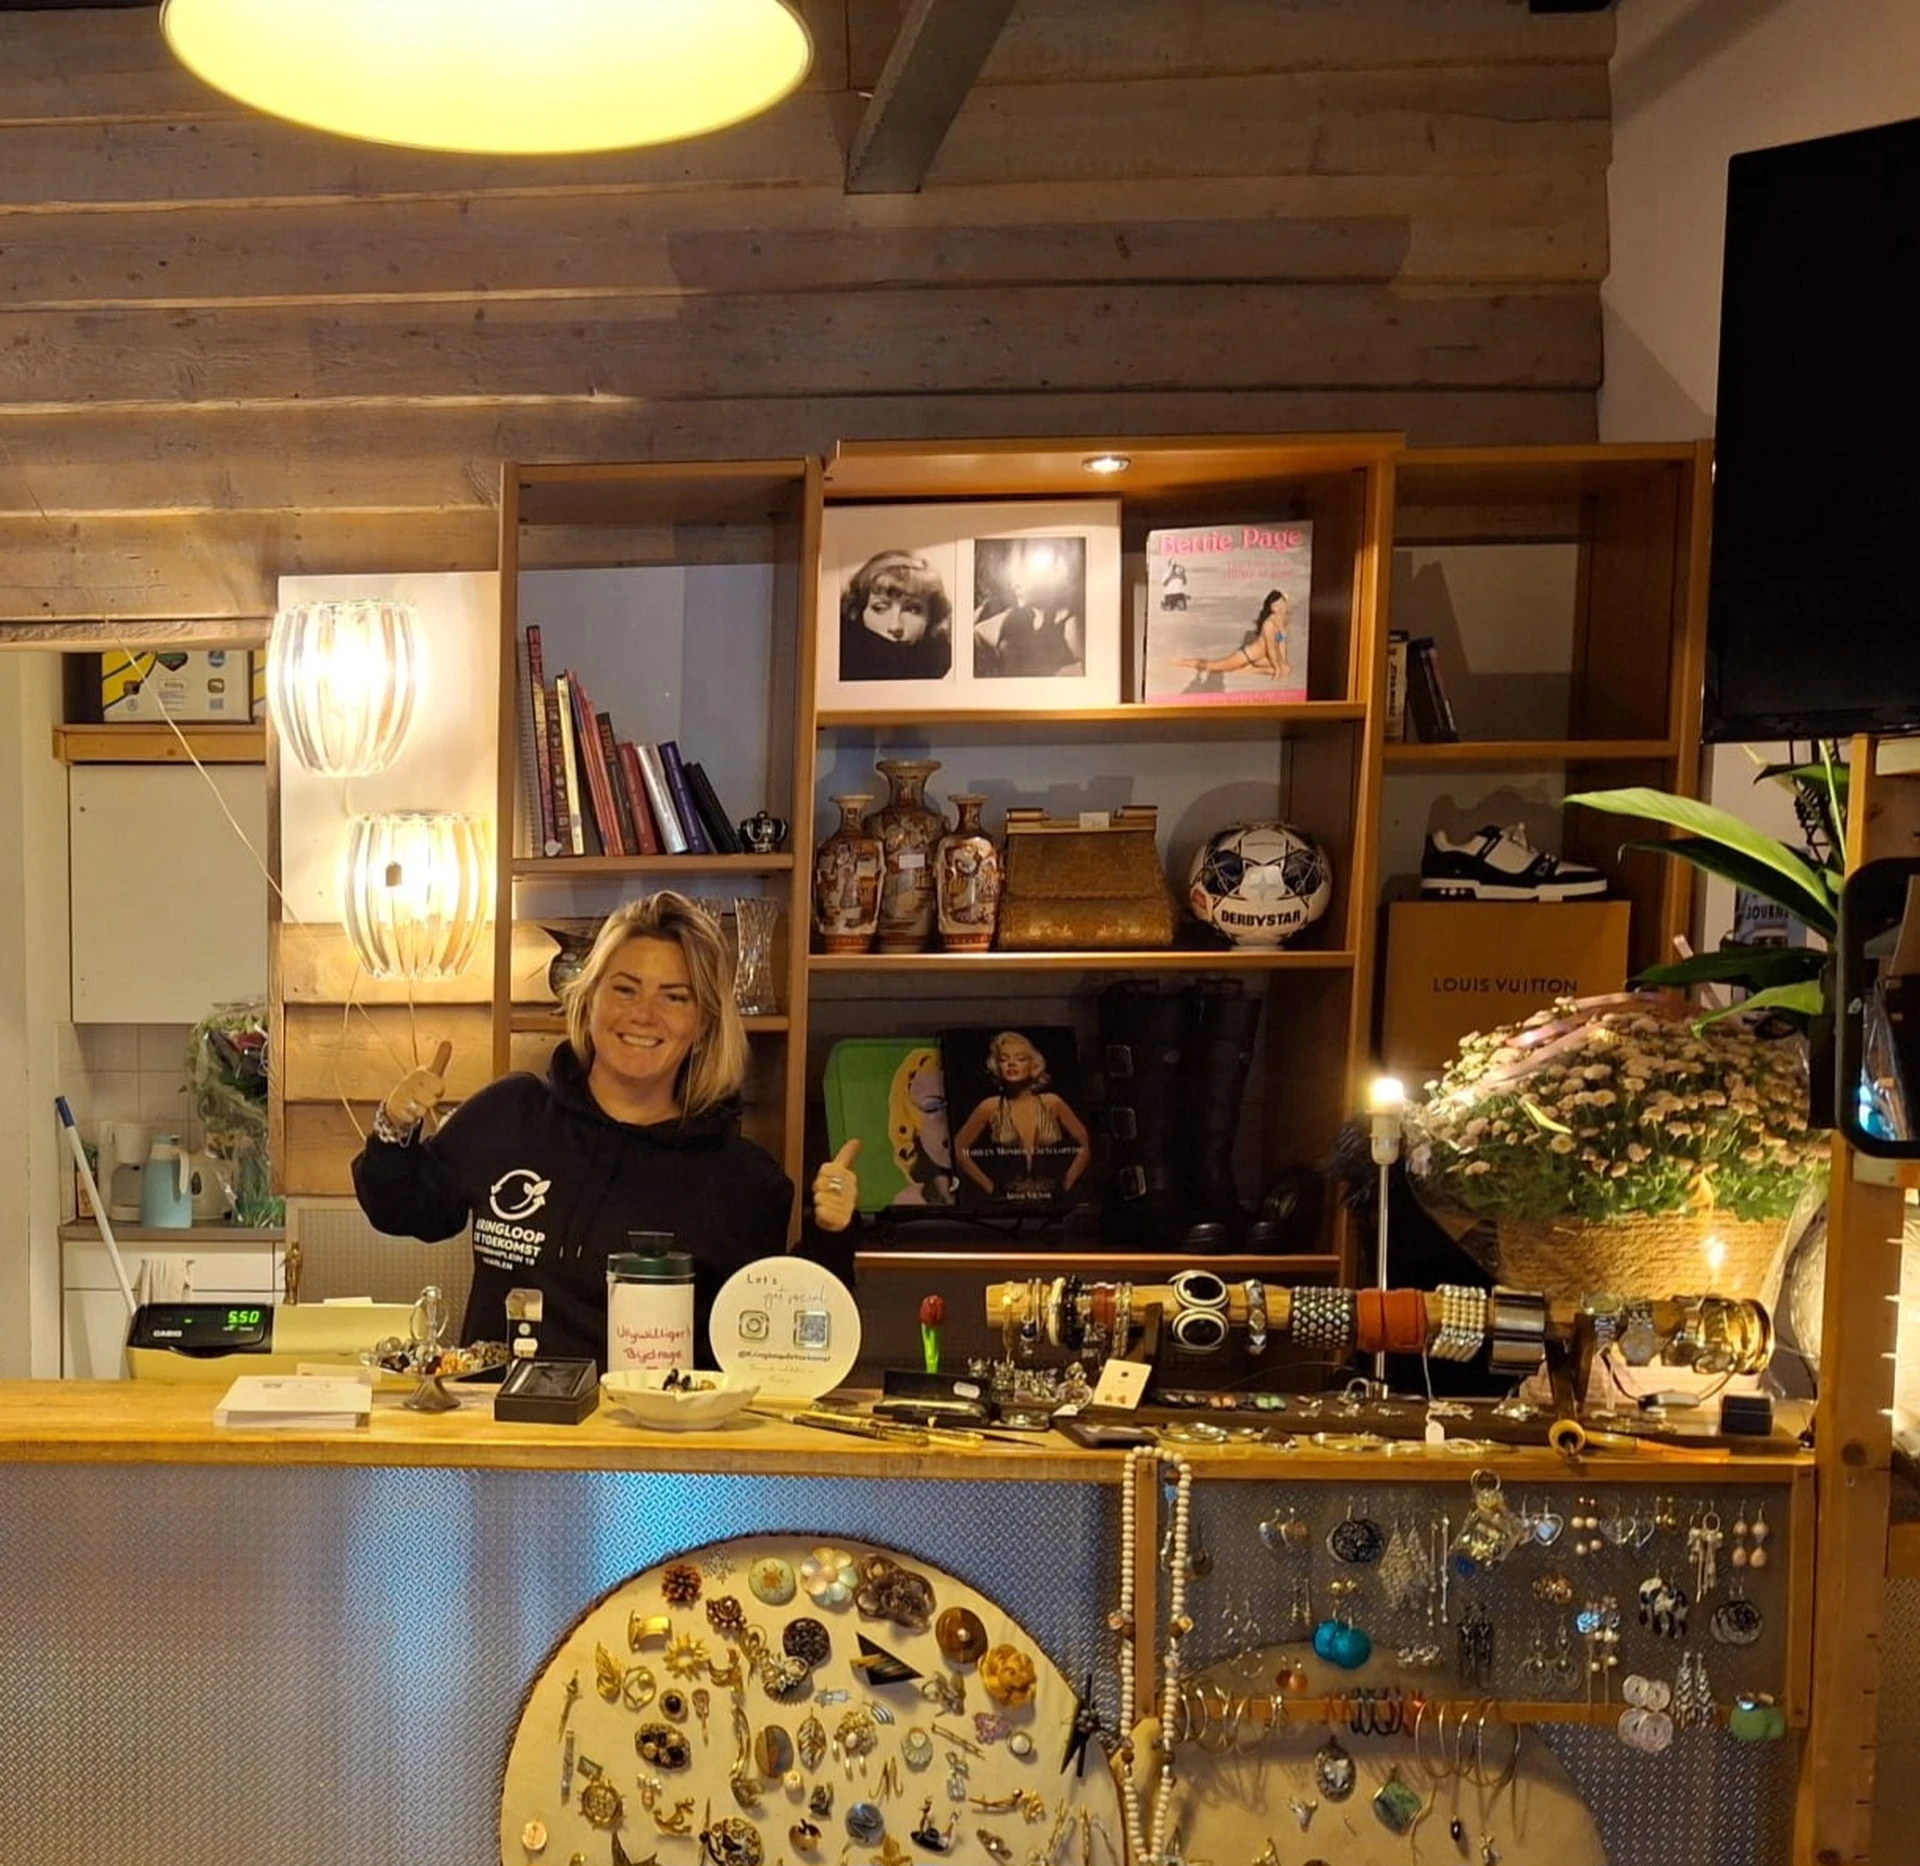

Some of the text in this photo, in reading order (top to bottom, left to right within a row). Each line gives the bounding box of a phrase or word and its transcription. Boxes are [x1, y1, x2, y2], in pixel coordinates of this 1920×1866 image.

[1242, 527, 1303, 553] Page
[1221, 909, 1301, 926] DERBYSTAR
[1433, 978, 1578, 994] LOUIS VUITTON
[481, 1233, 541, 1258] TOEKOMST
[153, 1329, 183, 1338] CASIO
